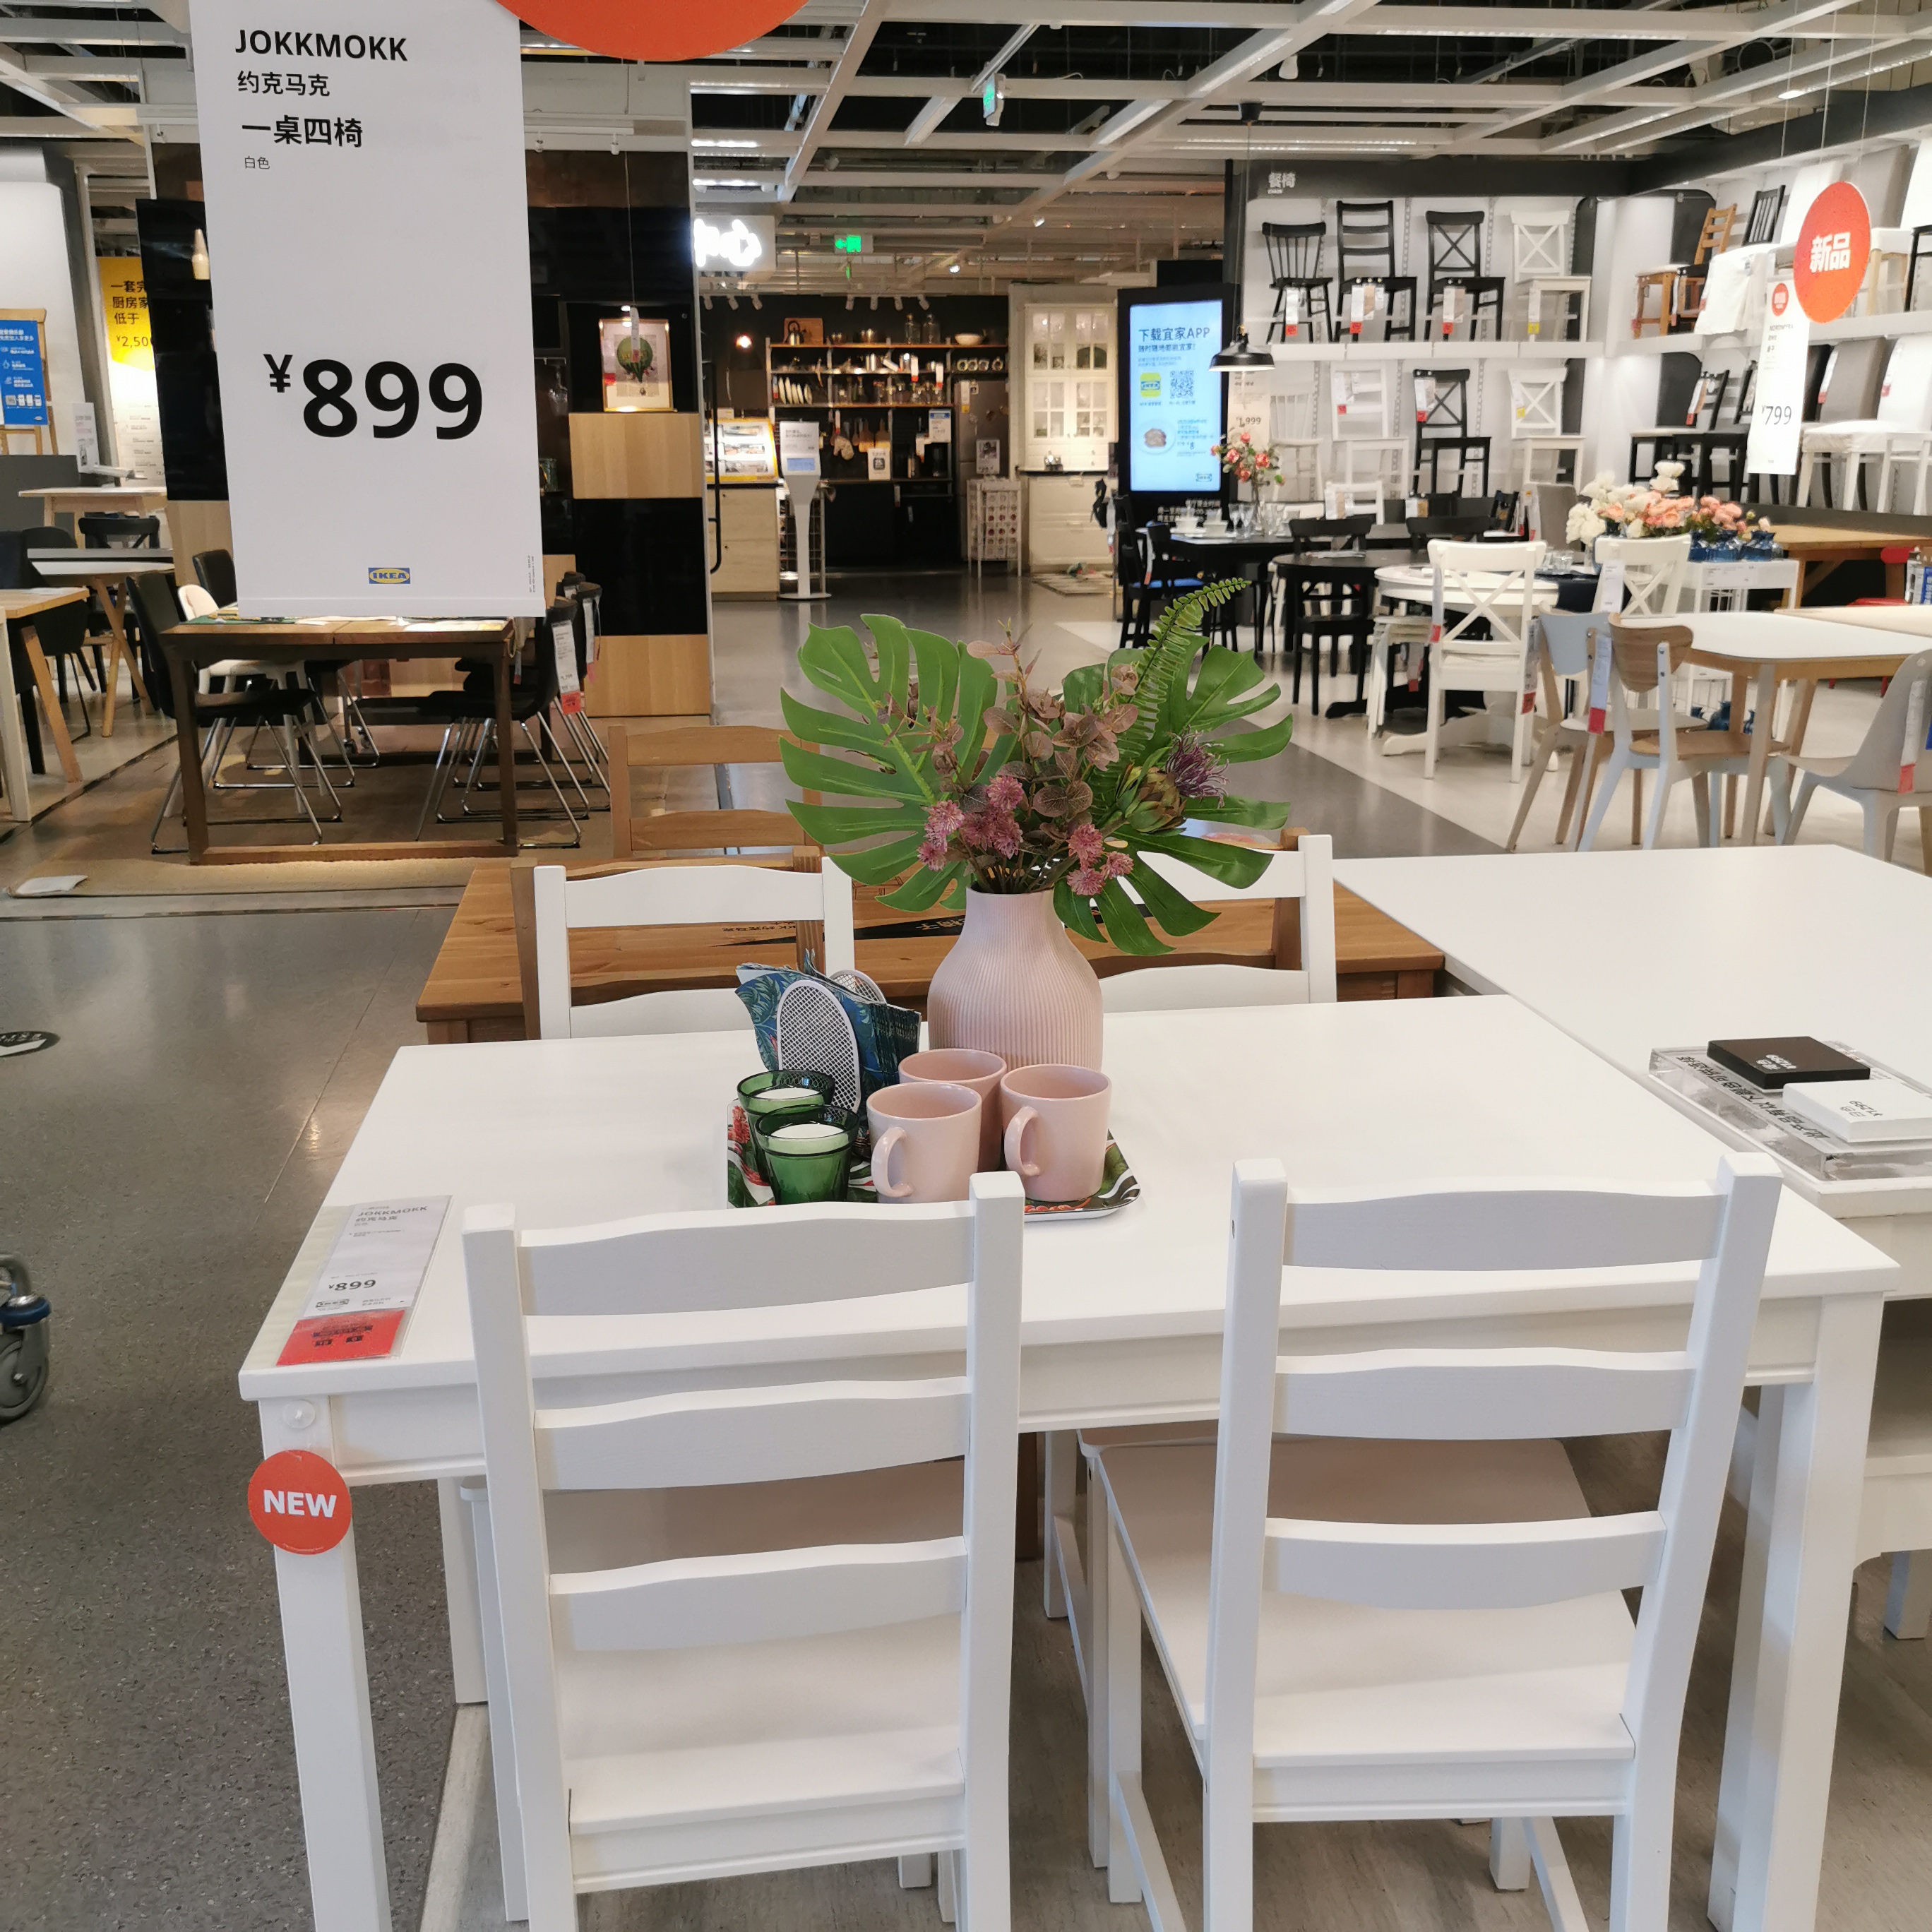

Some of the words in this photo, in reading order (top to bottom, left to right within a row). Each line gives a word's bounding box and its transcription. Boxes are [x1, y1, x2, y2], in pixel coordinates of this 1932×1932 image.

[235, 29, 407, 61] JOKKMOKK
[237, 71, 330, 97] 约克马克
[242, 114, 363, 148] 一桌四椅
[244, 155, 270, 169] 白色
[1809, 232, 1851, 273] 新品
[112, 297, 148, 309] 厨房家
[114, 312, 139, 325] 低于
[263, 354, 482, 440] ¥899
[1761, 405, 1792, 425] ¥799
[358, 1206, 428, 1217] JOKKMOKK
[328, 1279, 376, 1291] ¥899
[263, 1489, 337, 1517] NEW
